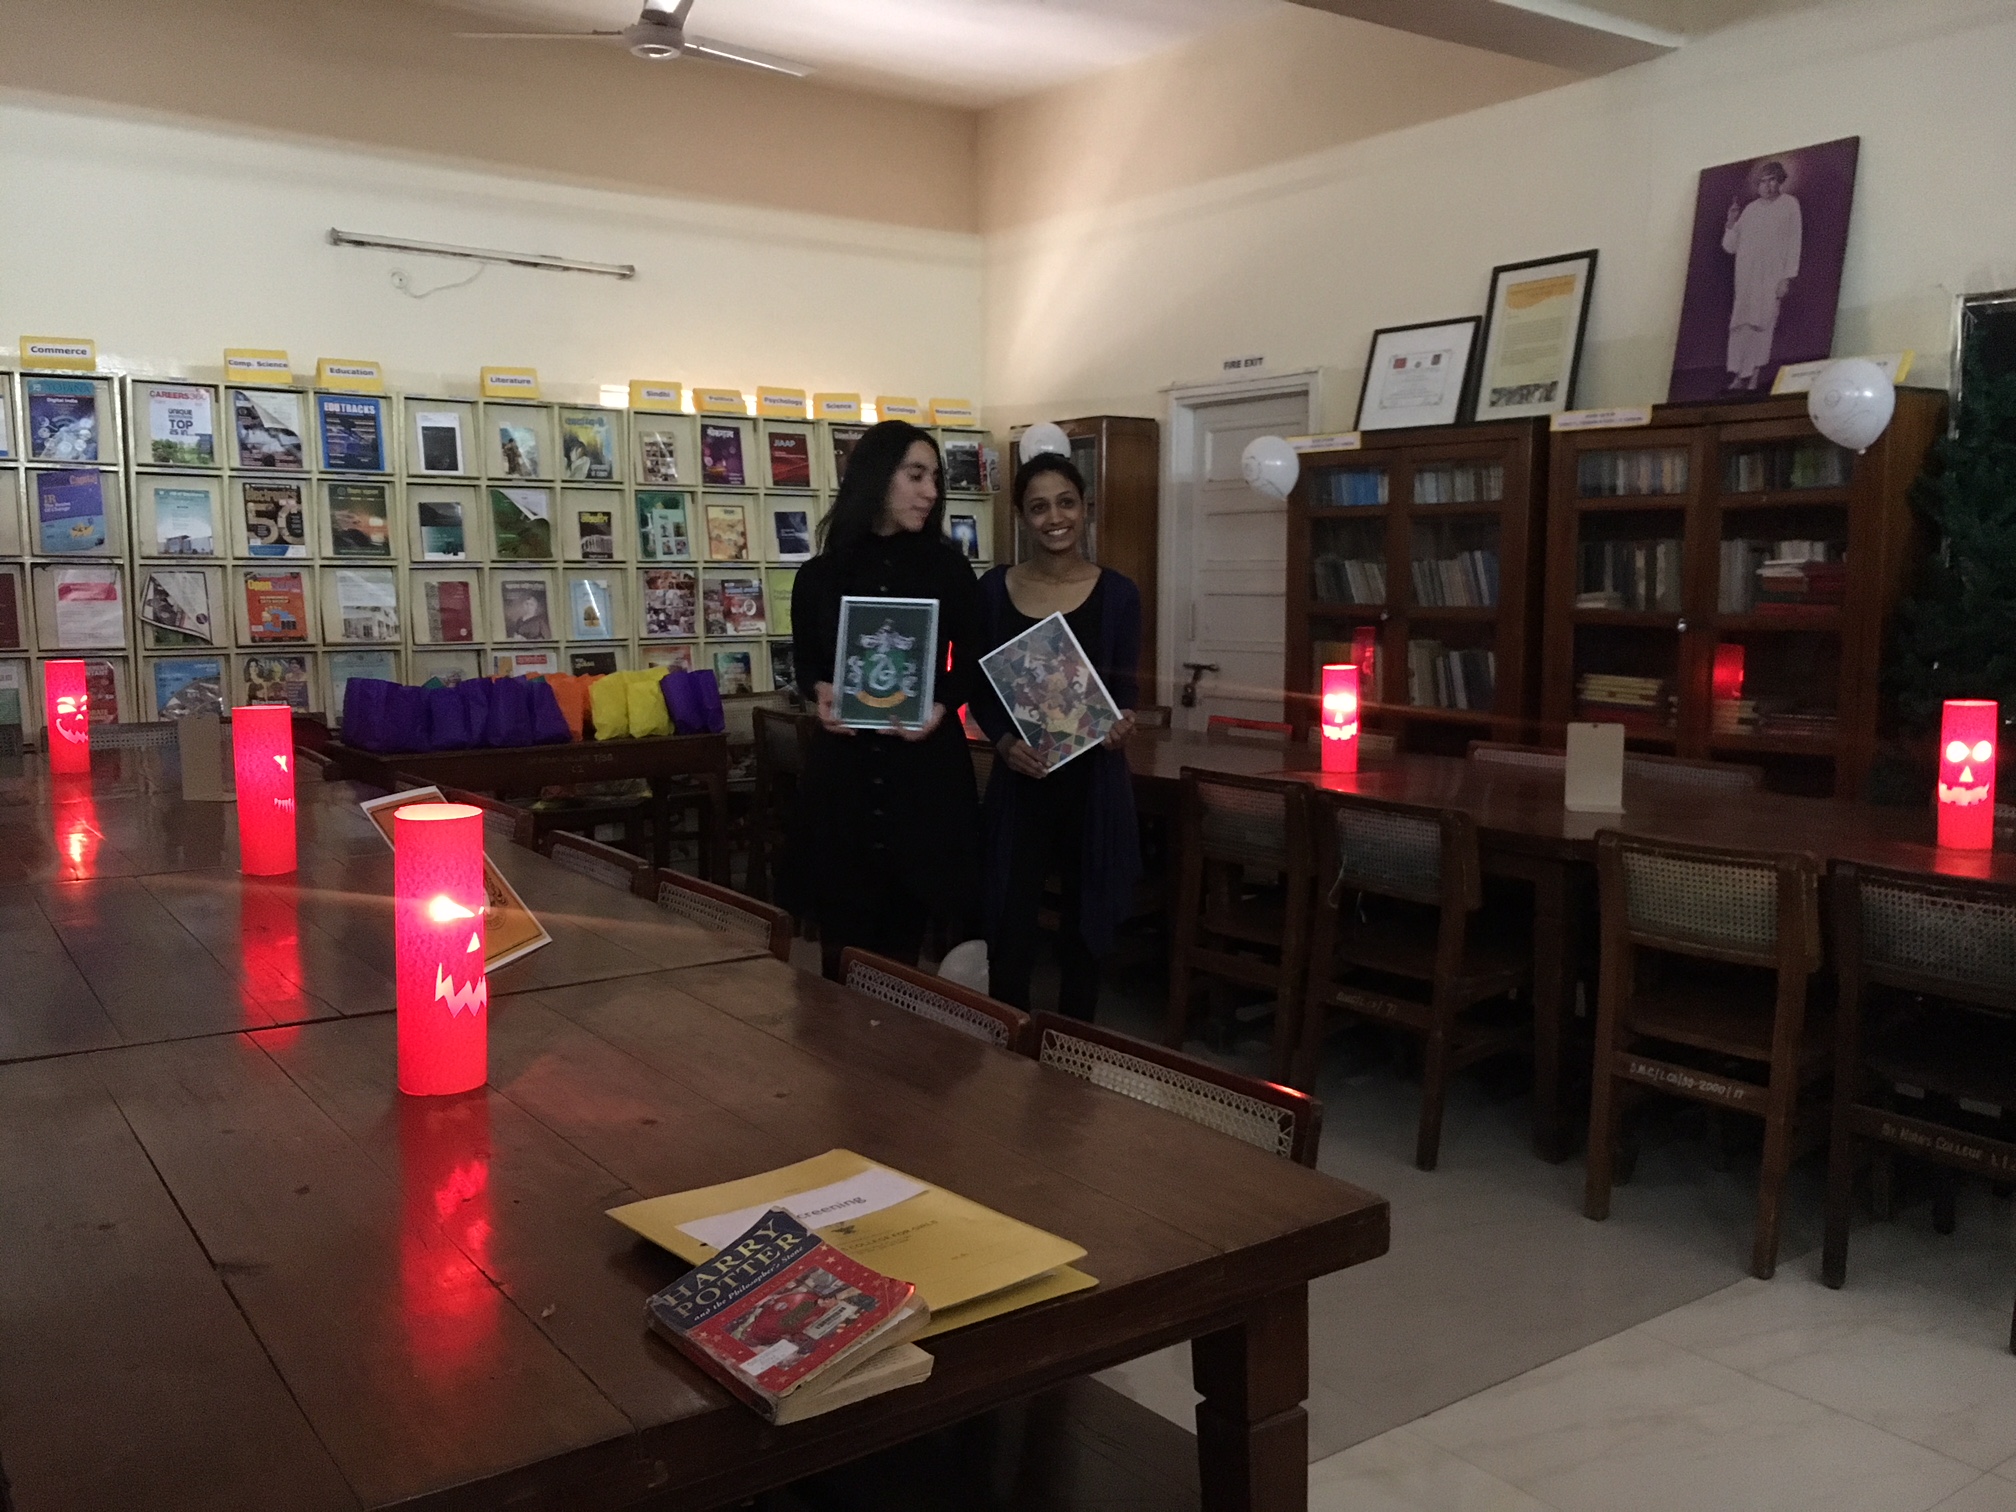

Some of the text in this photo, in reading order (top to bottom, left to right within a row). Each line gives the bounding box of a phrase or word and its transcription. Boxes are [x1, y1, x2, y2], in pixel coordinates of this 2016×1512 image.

[30, 345, 87, 356] Commerce
[228, 359, 255, 368] Comp.
[1223, 357, 1264, 370] FIRE EXIT
[329, 367, 374, 376] Education
[490, 377, 532, 385] Literature
[645, 390, 671, 398] Sindhi
[763, 396, 803, 406] Psychology
[825, 402, 852, 410] Science
[886, 406, 916, 414] Sociology
[935, 408, 972, 416] Newsletters
[168, 419, 194, 430] TOP
[796, 1196, 867, 1220] creening
[849, 1235, 890, 1250] COLLEGE
[662, 1217, 781, 1307] HARRY
[674, 1232, 803, 1319] POTTER
[694, 1308, 712, 1321] and
[713, 1297, 727, 1311] the
[728, 1262, 781, 1301] Philosopher's
[781, 1244, 805, 1264] Stone
